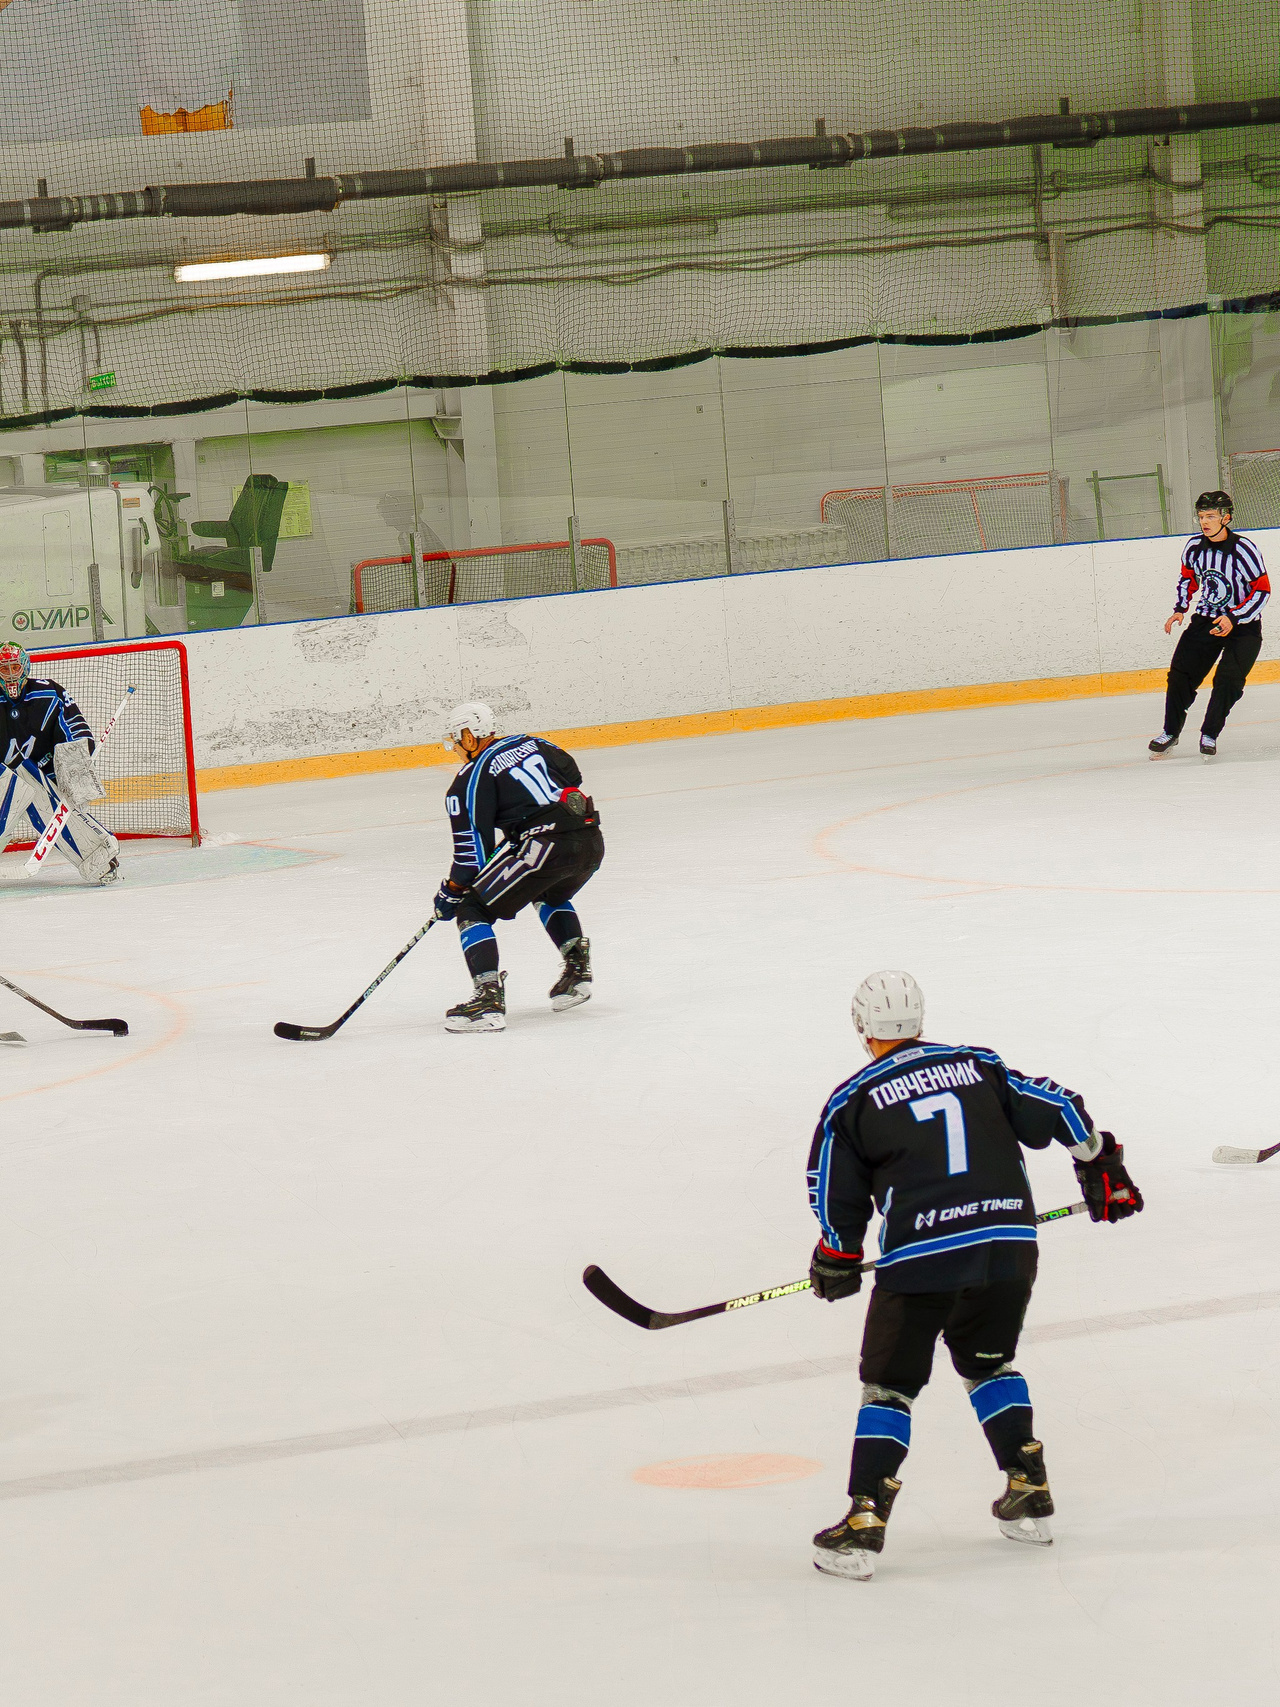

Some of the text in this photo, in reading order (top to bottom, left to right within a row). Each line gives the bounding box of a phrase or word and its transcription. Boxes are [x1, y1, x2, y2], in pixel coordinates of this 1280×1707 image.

[100, 717, 116, 743] CCM
[509, 754, 563, 807] 10
[34, 803, 69, 862] CCM
[71, 808, 103, 836] TRUE
[520, 822, 556, 841] CCM
[896, 1023, 903, 1033] 7
[868, 1059, 983, 1110] ТОВЧЕННИК
[908, 1091, 968, 1176] 7
[939, 1198, 1023, 1222] ONE TIMER
[725, 1280, 813, 1312] ONE TIMER
